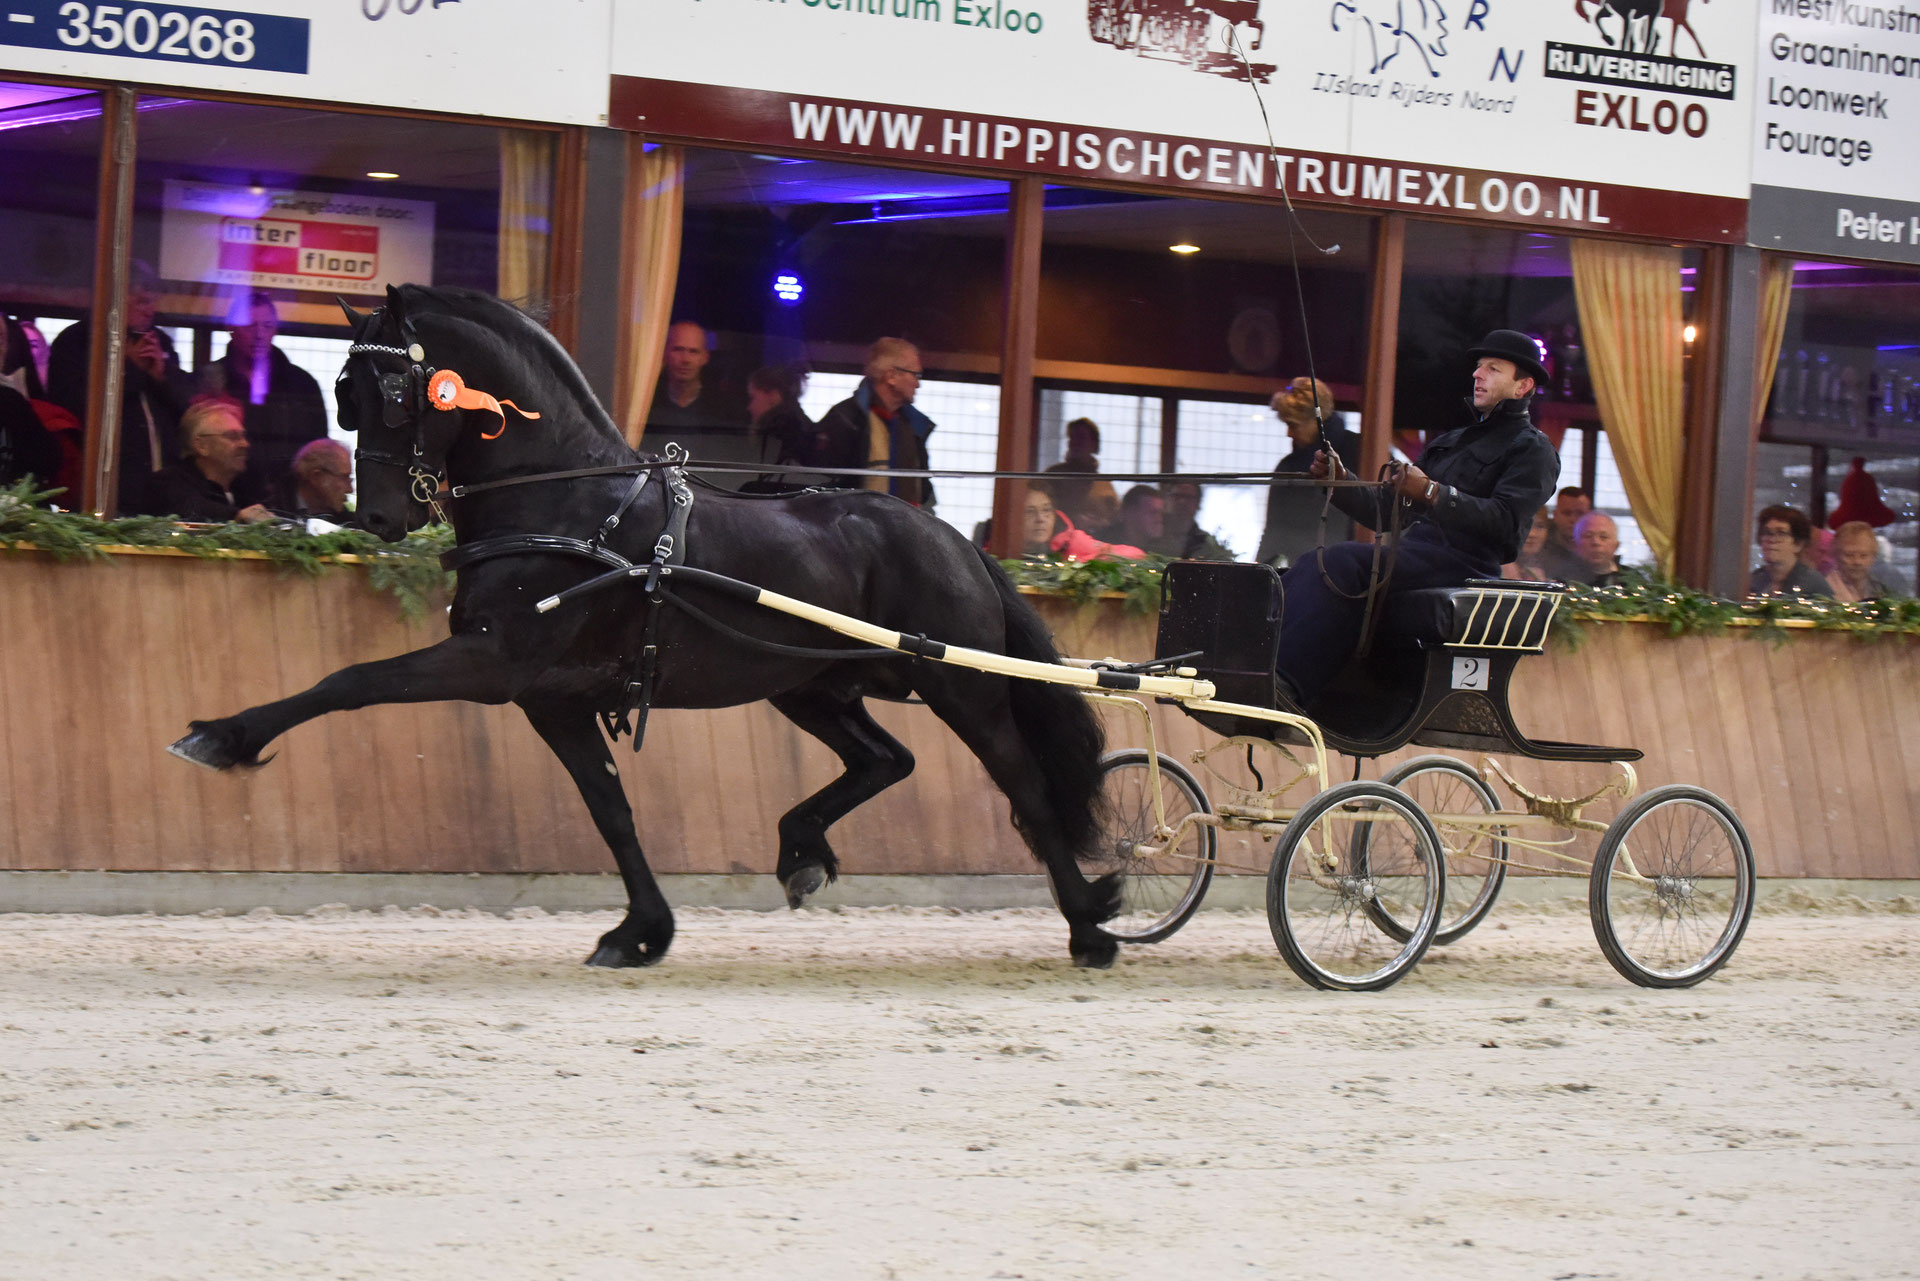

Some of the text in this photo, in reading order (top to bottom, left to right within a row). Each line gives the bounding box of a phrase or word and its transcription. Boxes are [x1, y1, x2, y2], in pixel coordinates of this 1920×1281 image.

[56, 1, 256, 62] 350268
[802, 0, 1044, 34] ntrum Exloo
[1464, 0, 1490, 31] R
[1489, 46, 1525, 83] N
[1547, 48, 1733, 93] RIJVERENIGING
[1311, 72, 1517, 114] IJsland Rijders Noord
[1767, 76, 1889, 120] Loonwerk
[1575, 89, 1708, 138] EXLOO
[788, 101, 1610, 224] WWW.HIPPISCHCENTRUMEXLOO.NL
[1765, 122, 1873, 167] Fourage
[226, 220, 297, 243] inter
[1836, 208, 1905, 243] Peter
[305, 251, 373, 274] floor
[1459, 658, 1479, 688] 2
